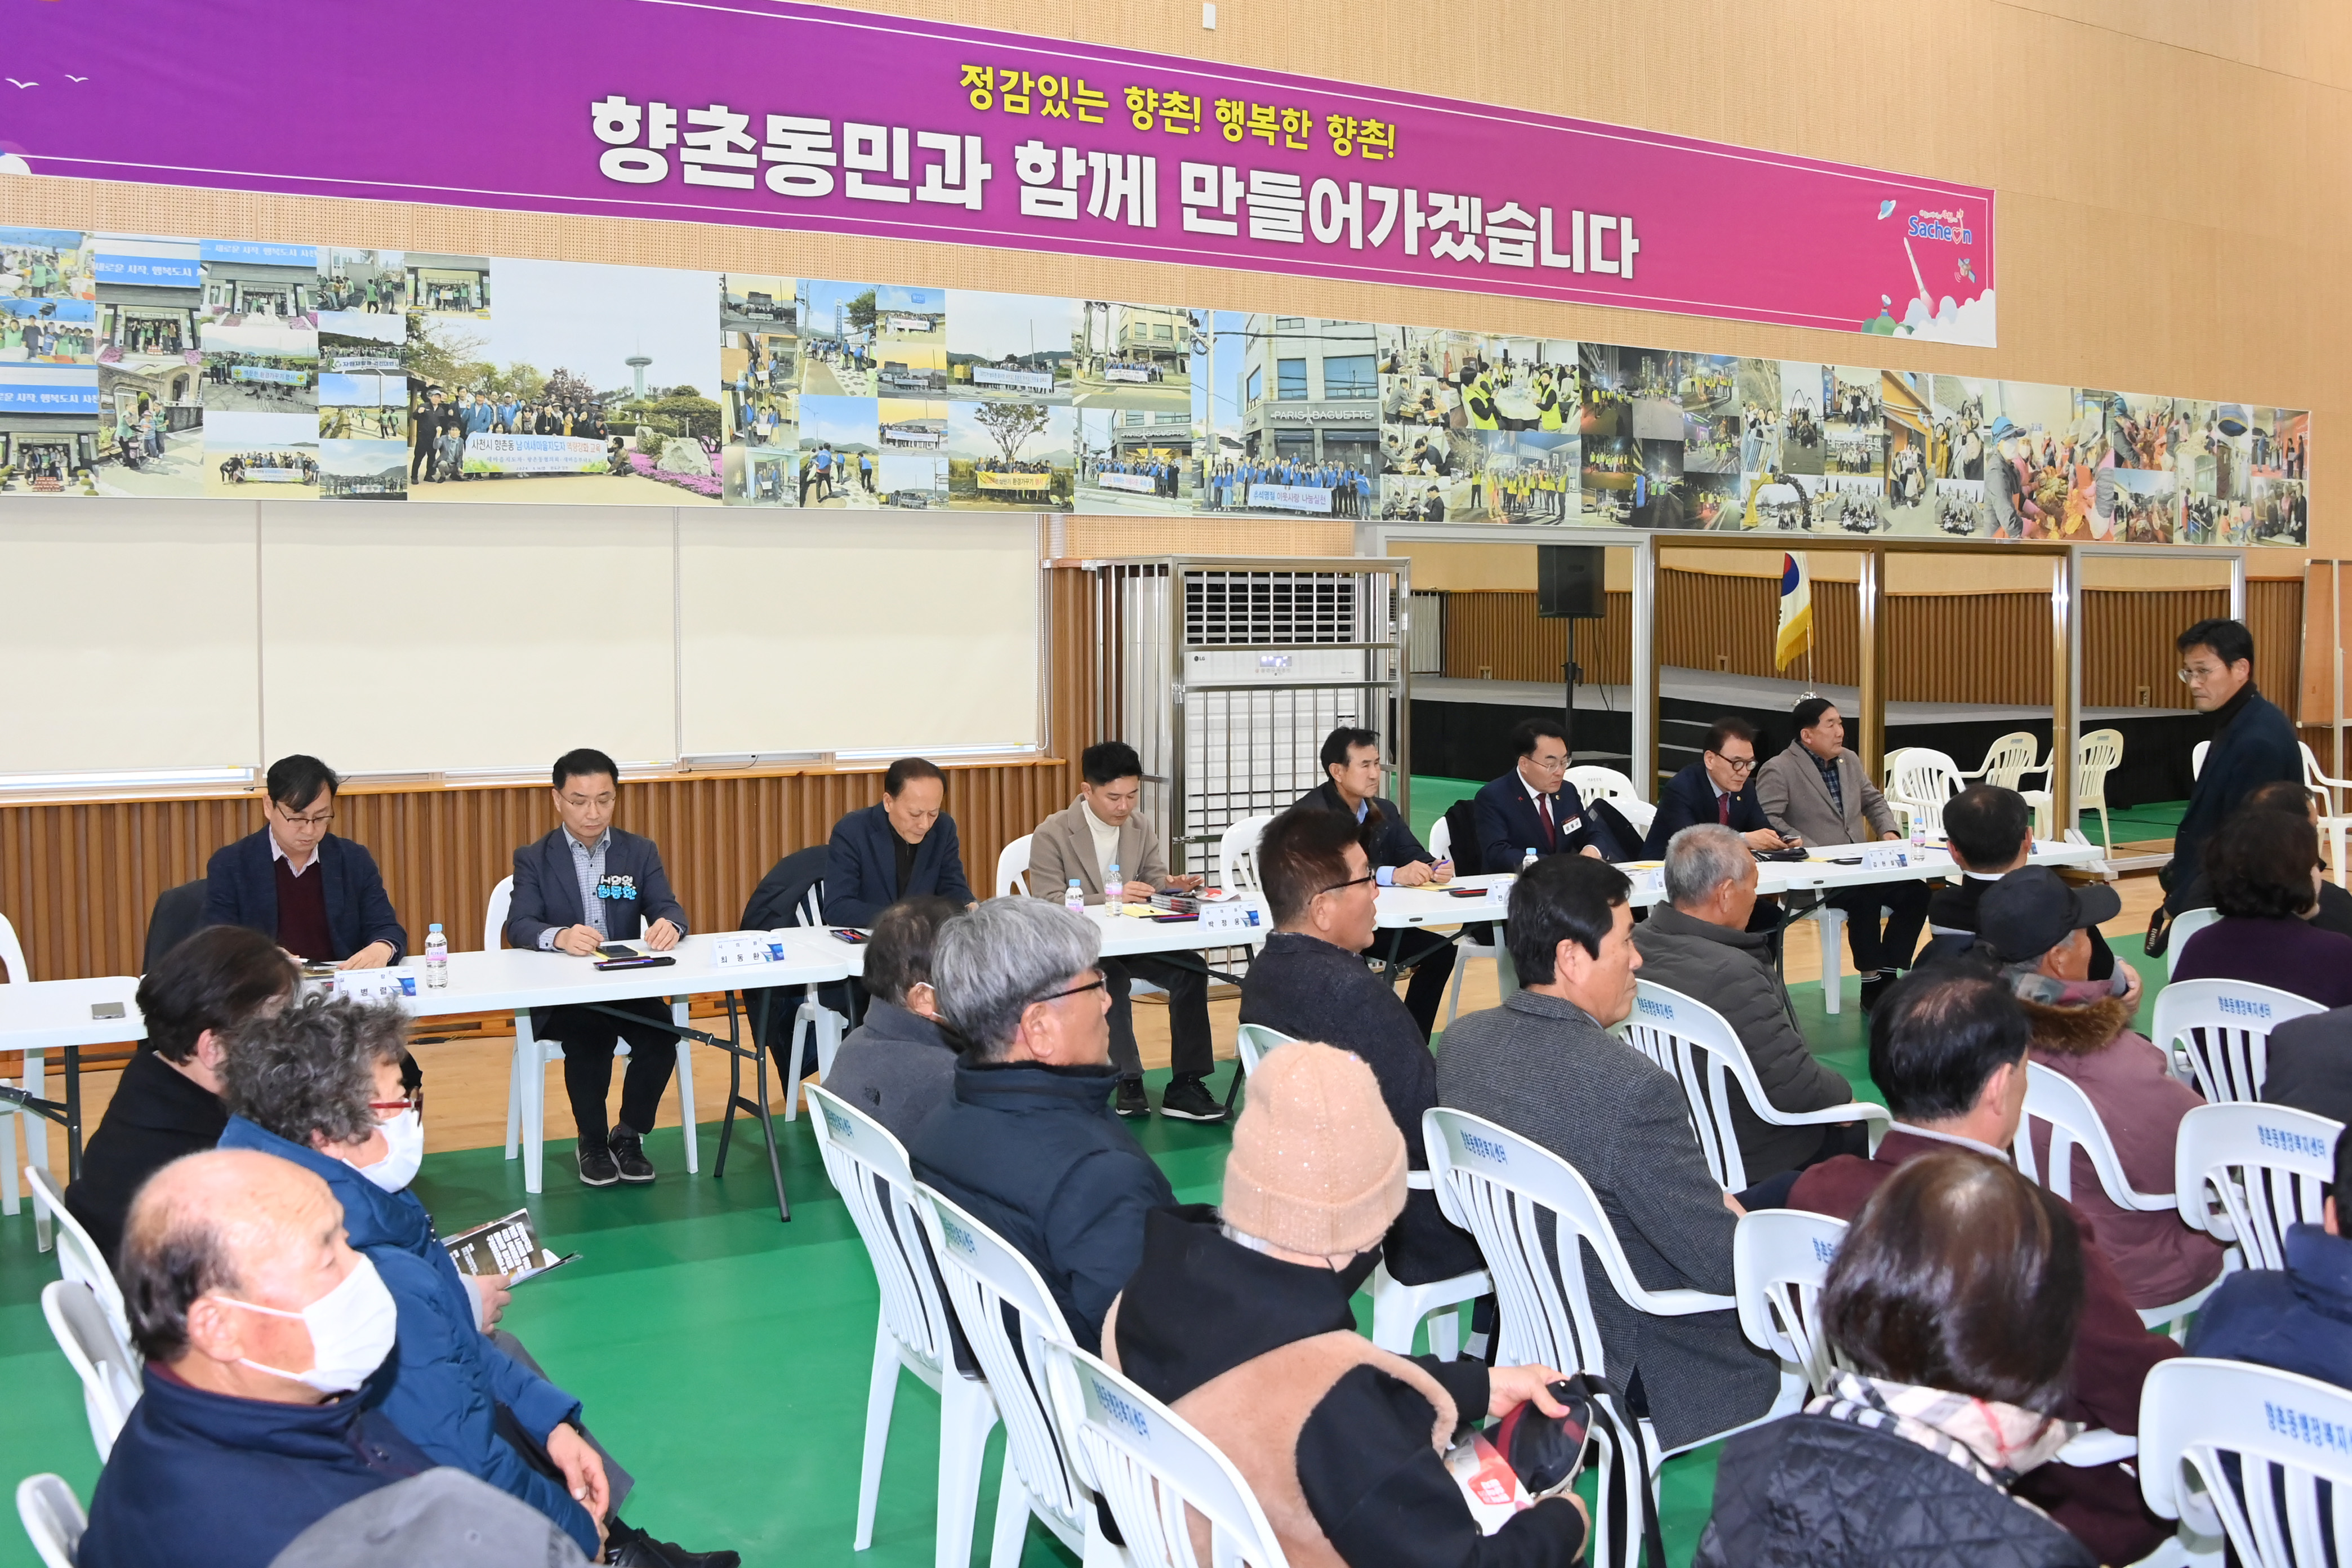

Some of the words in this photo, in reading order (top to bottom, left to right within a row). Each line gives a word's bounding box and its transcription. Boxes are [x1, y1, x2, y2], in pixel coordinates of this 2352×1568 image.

[960, 63, 1109, 124] 정감있는
[1124, 86, 1201, 135] 향촌!
[1214, 98, 1313, 150] 행복한
[1326, 114, 1395, 160] 향촌!
[591, 95, 992, 211] 향촌동민과
[1014, 139, 1157, 229] 함께
[1181, 161, 1640, 279] 만들어가겠습니다
[152, 266, 192, 277] 행복도시
[41, 394, 79, 403] 행복도시
[1275, 411, 1304, 420] PARIS
[1312, 411, 1373, 420] BAGUETTE
[471, 439, 493, 451] 사천시
[495, 440, 515, 451] 향촌동
[567, 442, 589, 453] 역량강화
[1277, 492, 1300, 503] 이웃사랑
[1302, 494, 1326, 505] 나눔실천
[2146, 928, 2158, 950] Canon
